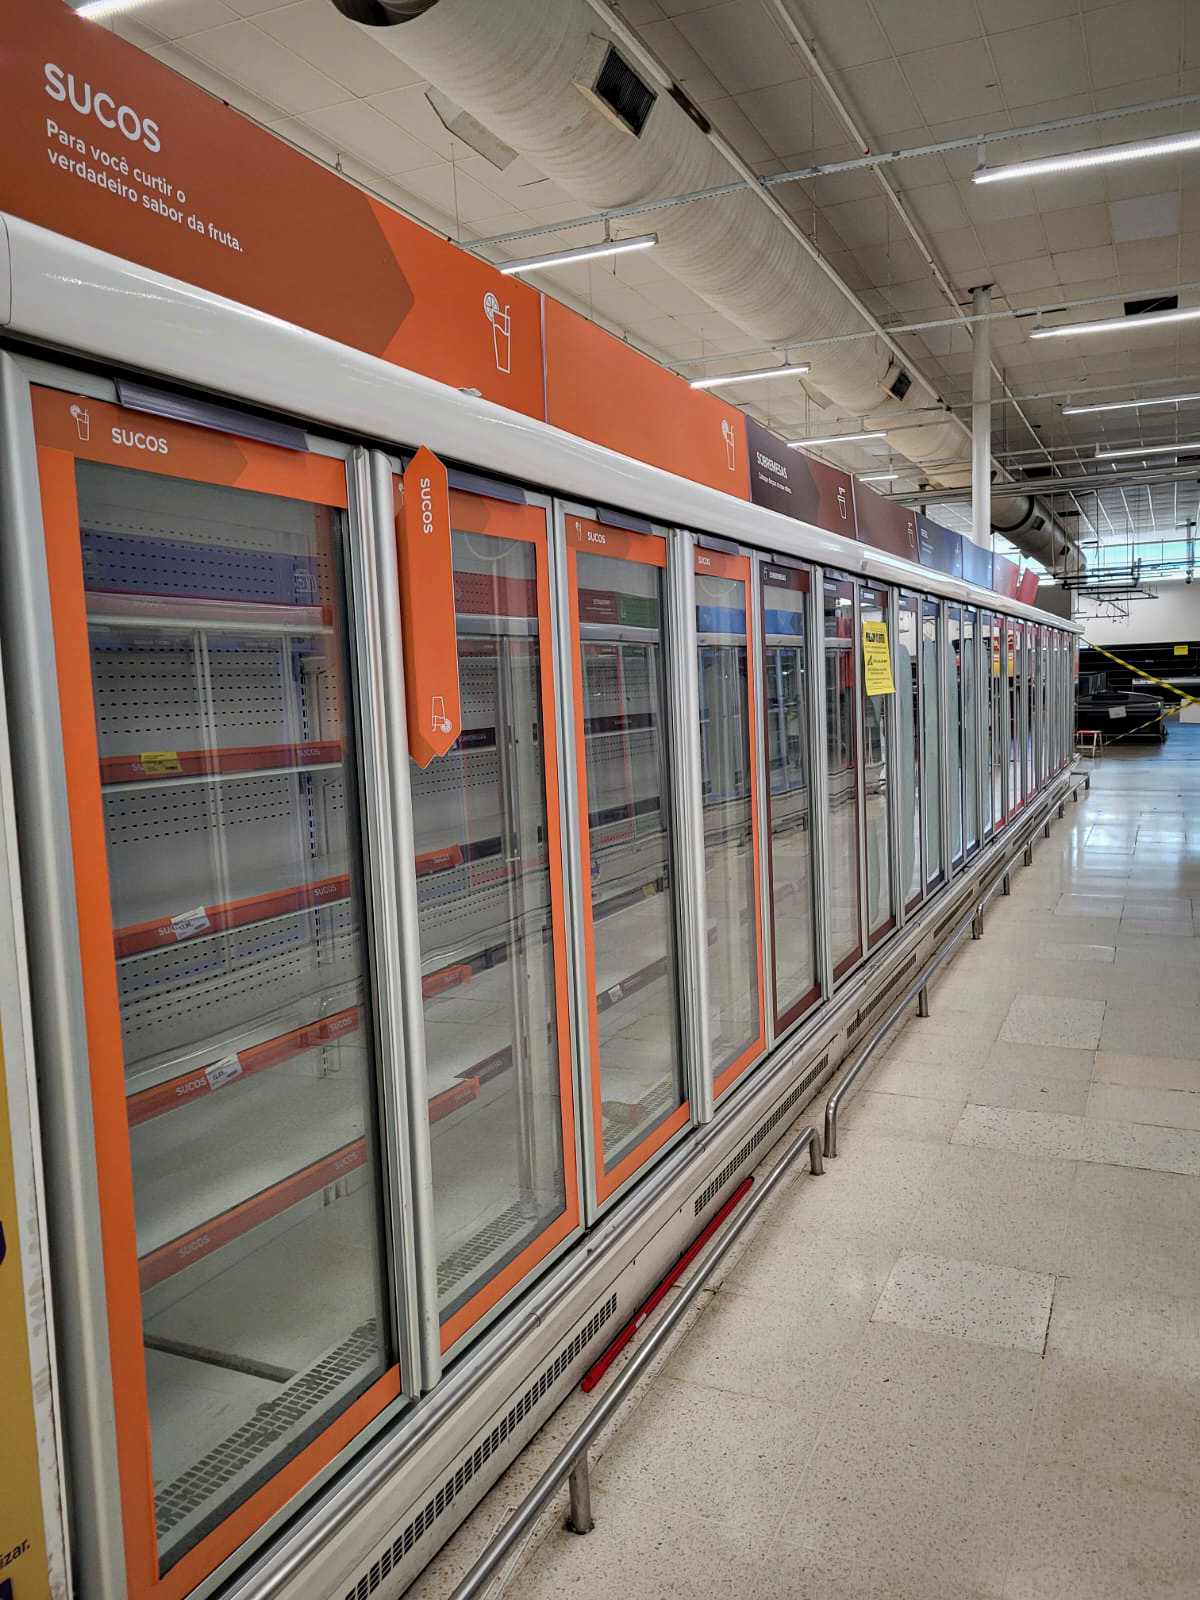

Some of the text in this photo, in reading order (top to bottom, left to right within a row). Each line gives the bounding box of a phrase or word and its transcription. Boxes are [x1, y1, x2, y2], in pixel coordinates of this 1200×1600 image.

[44, 62, 161, 153] SUCOS
[46, 118, 186, 203] Para você curtir o
[47, 148, 244, 252] verdadeiro sabor da fruta.
[111, 427, 169, 454] SUCOS
[420, 477, 433, 534] SUCOS
[587, 531, 606, 544] SUCOS
[329, 1016, 353, 1032] SUCOS
[175, 1076, 208, 1097] SUCOS
